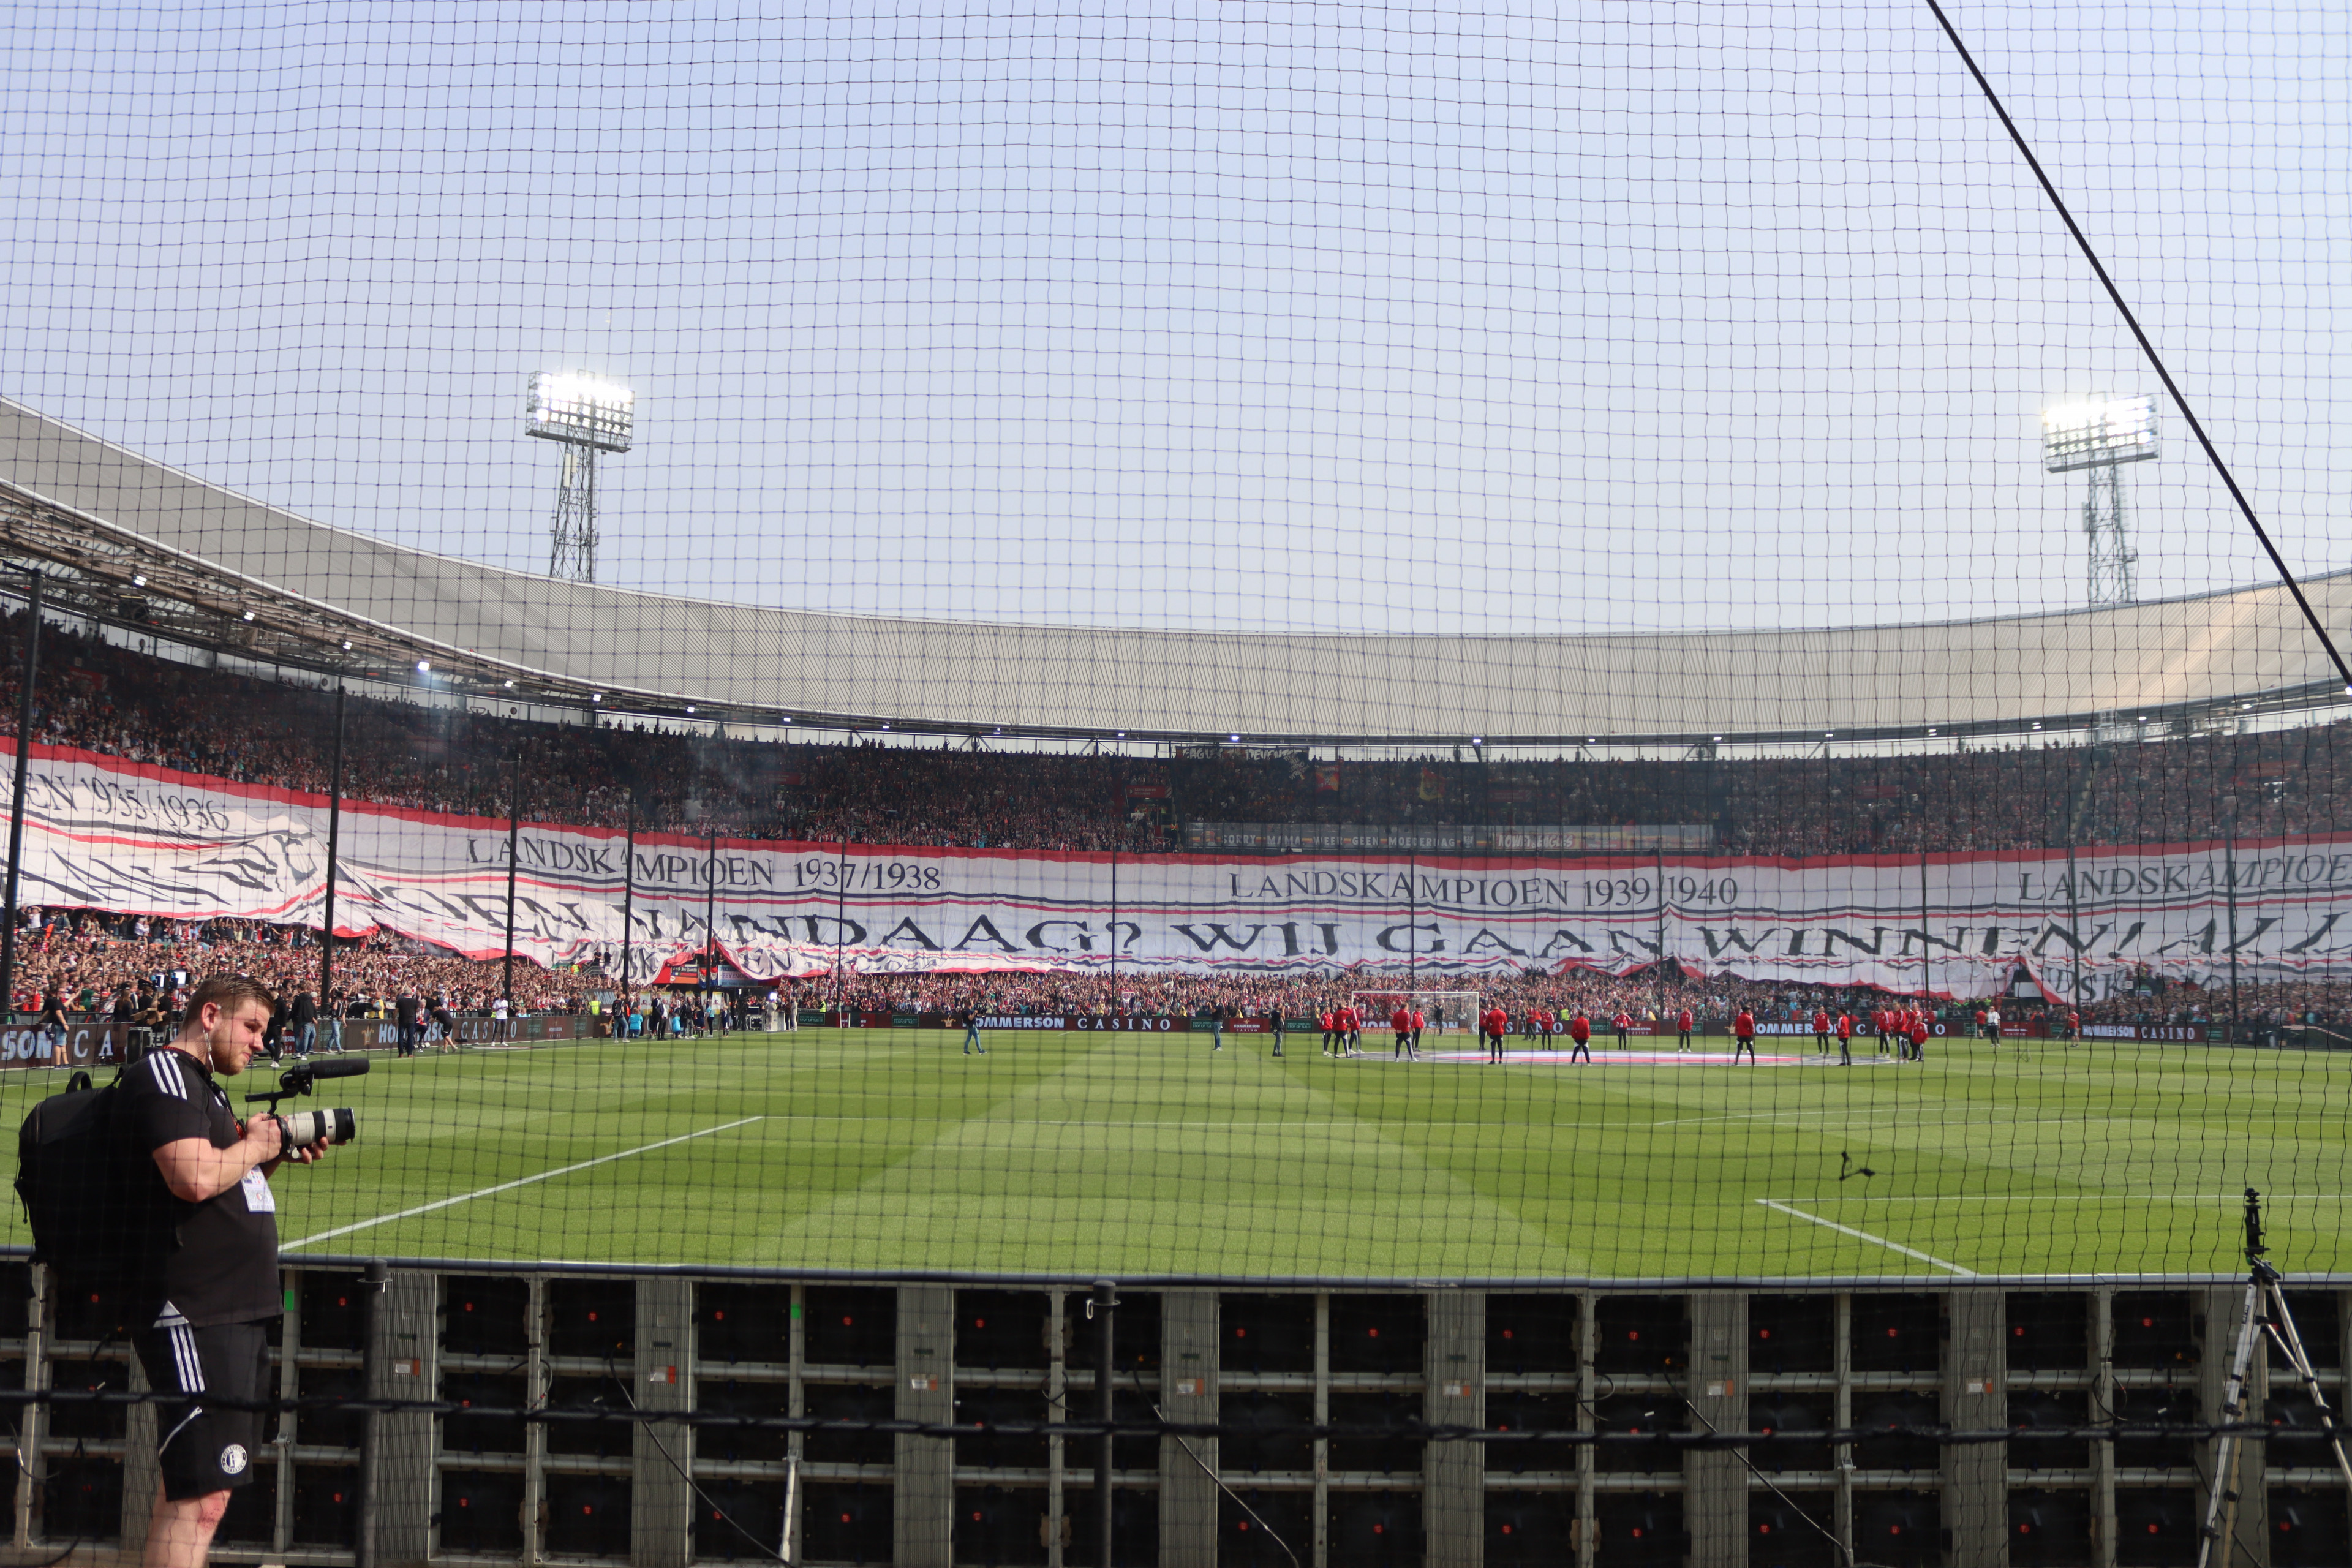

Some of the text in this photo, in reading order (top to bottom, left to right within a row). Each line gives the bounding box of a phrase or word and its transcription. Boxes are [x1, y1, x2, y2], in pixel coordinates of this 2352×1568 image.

[80, 777, 230, 831] 1935/1936
[1223, 834, 1256, 845] SORRY
[1267, 835, 1301, 845] MAMA
[1313, 836, 1343, 846] WEER
[1352, 836, 1379, 846] GEEN
[794, 859, 941, 890] 1937/1938
[1229, 869, 1569, 907] LANDSKAMPIOEN
[1170, 921, 1342, 957] WIJ
[1376, 921, 1671, 958] GAAN
[1695, 918, 2146, 959] WINNEN!
[461, 1020, 517, 1039] CASO
[962, 1016, 1170, 1030] OMMERSON CASINO
[1471, 1022, 1563, 1033] CSINO
[2082, 1025, 2136, 1038] HOMMERSON
[2141, 1027, 2195, 1039] CASINO
